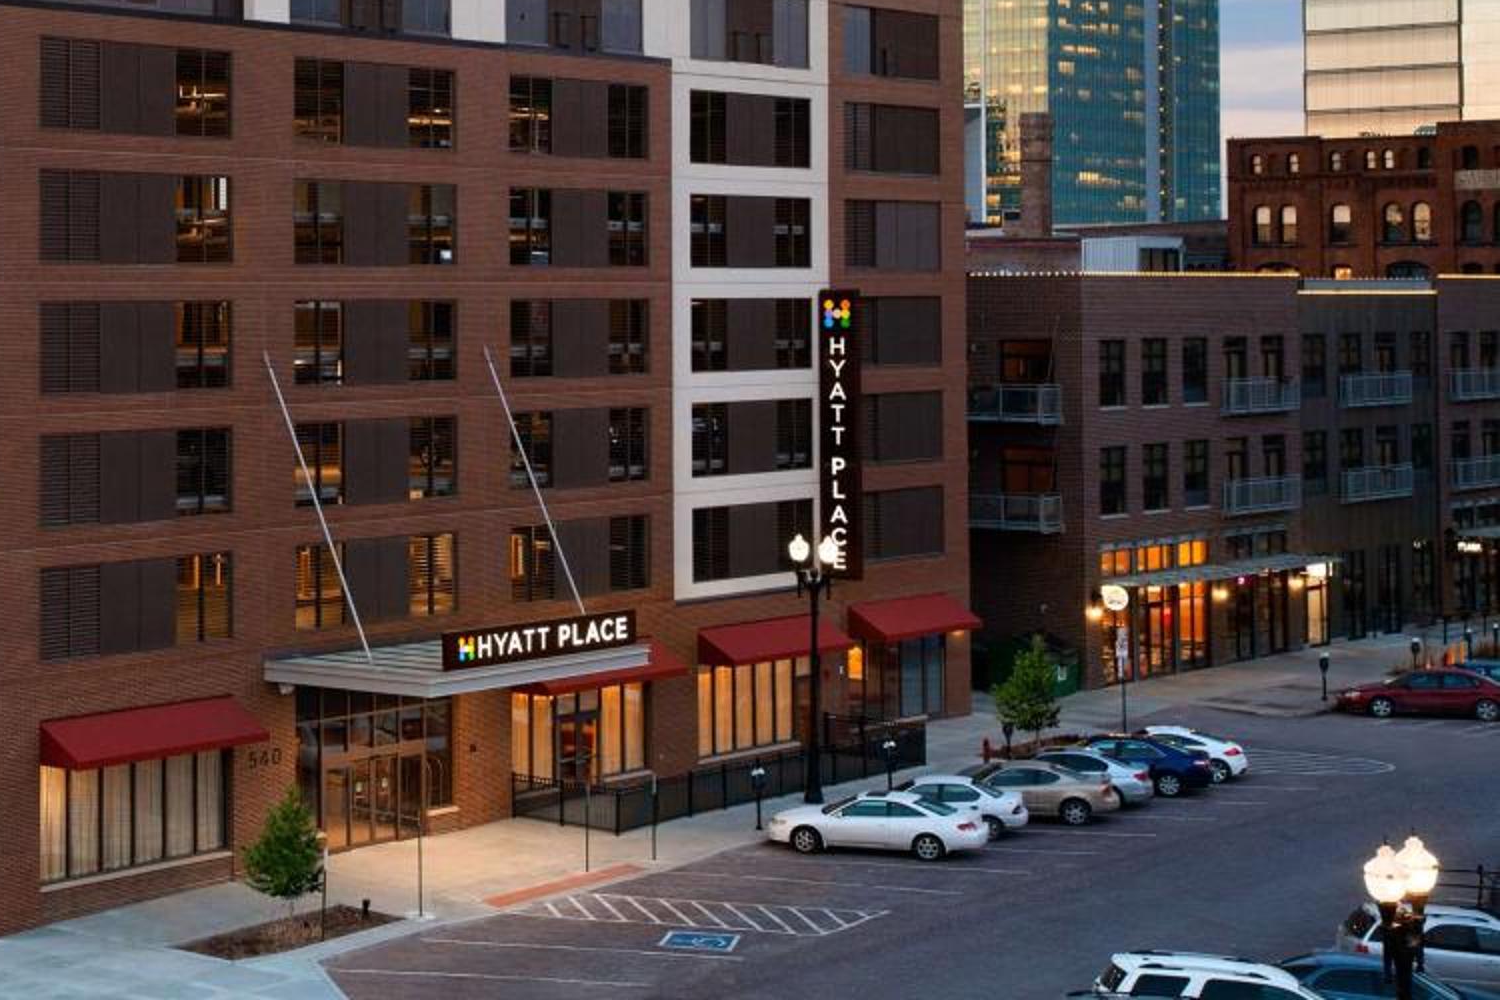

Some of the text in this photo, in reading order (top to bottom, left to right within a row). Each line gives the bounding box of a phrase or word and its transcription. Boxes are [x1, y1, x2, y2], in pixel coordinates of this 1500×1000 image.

[828, 336, 849, 570] HYATT PLACE
[477, 616, 628, 659] HYATT PLACE
[248, 748, 283, 769] 540
